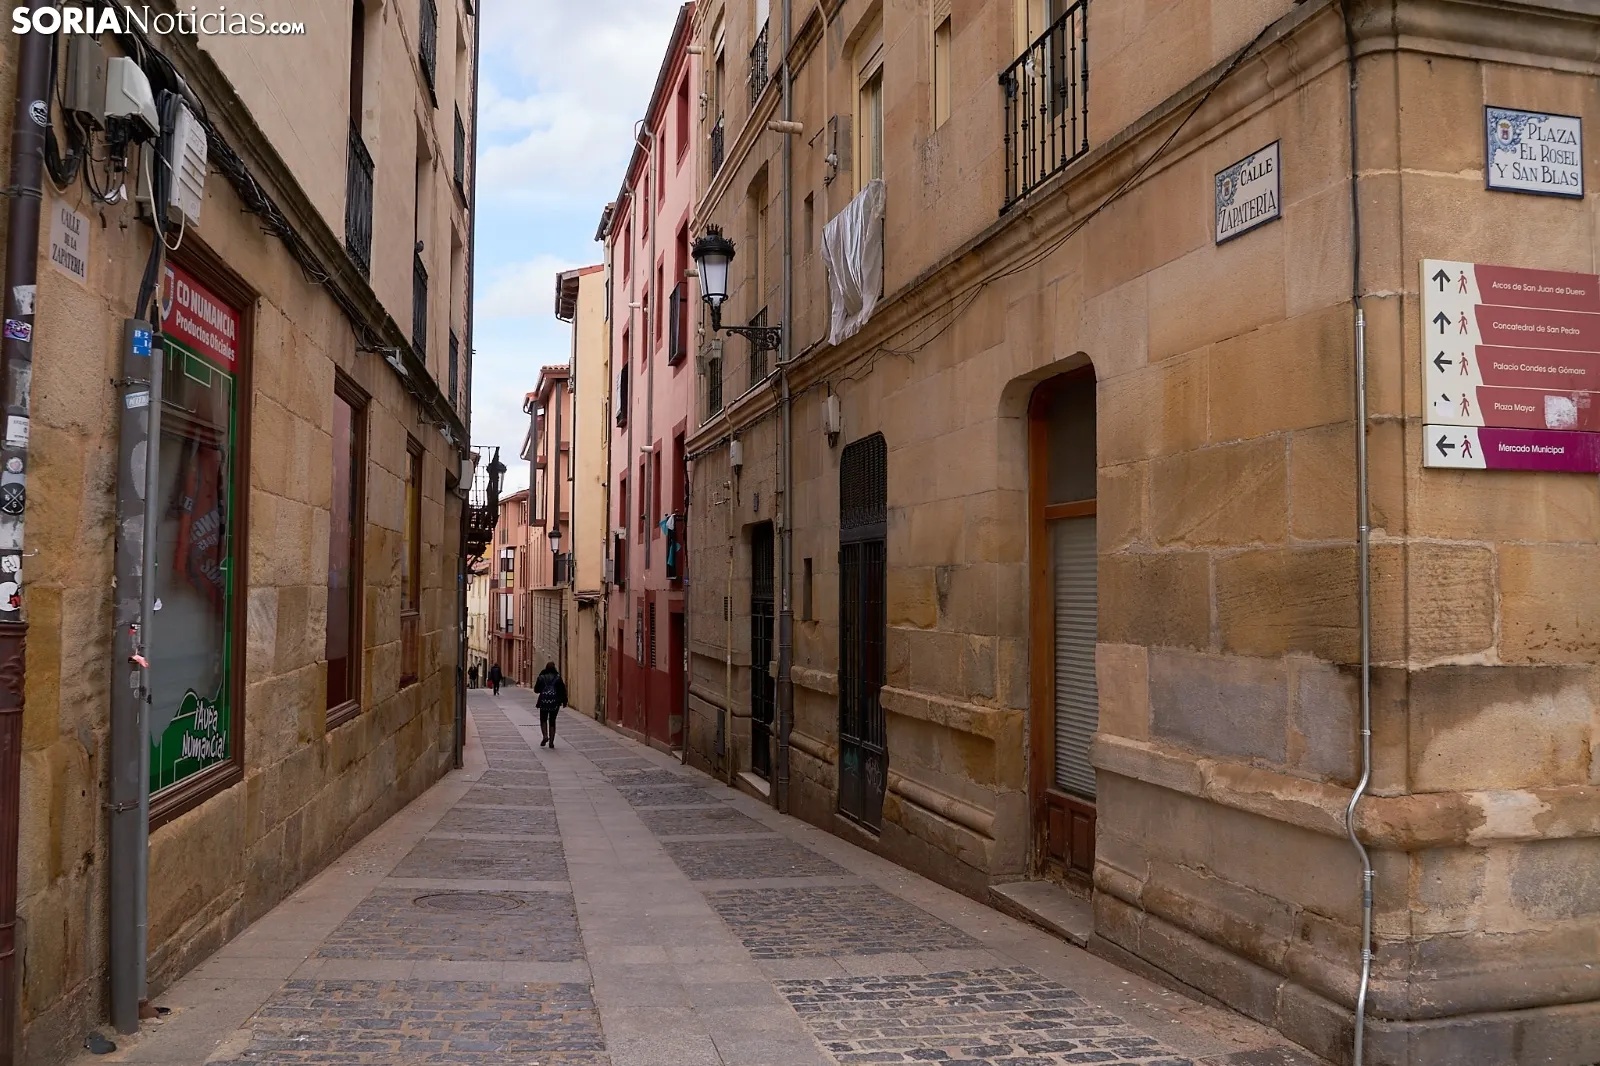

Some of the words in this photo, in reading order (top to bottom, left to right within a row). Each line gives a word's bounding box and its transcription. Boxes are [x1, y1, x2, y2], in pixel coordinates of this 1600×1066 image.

[1527, 122, 1578, 146] PLAZA
[1520, 142, 1537, 161] EL
[1540, 144, 1578, 167] ROSEL
[1240, 157, 1273, 187] CALLE
[1495, 162, 1508, 178] Y
[1512, 161, 1538, 182] SAN
[1541, 165, 1579, 187] BLAS
[61, 207, 81, 236] CALLE
[1219, 188, 1277, 234] ZAPATERÍA
[1492, 281, 1512, 290] Arcos
[1512, 283, 1522, 291] de
[1523, 283, 1536, 292] San
[1537, 285, 1554, 293] Juan
[1565, 287, 1586, 296] Duero
[176, 279, 190, 308] CD
[190, 289, 235, 341] NUMANCIA
[175, 310, 210, 346] Productos
[1492, 321, 1535, 332] Concatedral
[1536, 324, 1546, 332] de
[1546, 325, 1560, 333] San
[1560, 326, 1581, 335] Pedro
[1493, 362, 1519, 371] Palacio
[1519, 363, 1547, 373] Condes
[1547, 365, 1557, 373] de
[1558, 366, 1586, 375] Gómara
[1494, 402, 1513, 411] Plaza
[1514, 403, 1535, 413] Mayor
[1498, 443, 1530, 453] Mercado
[1531, 444, 1565, 455] Municipal
